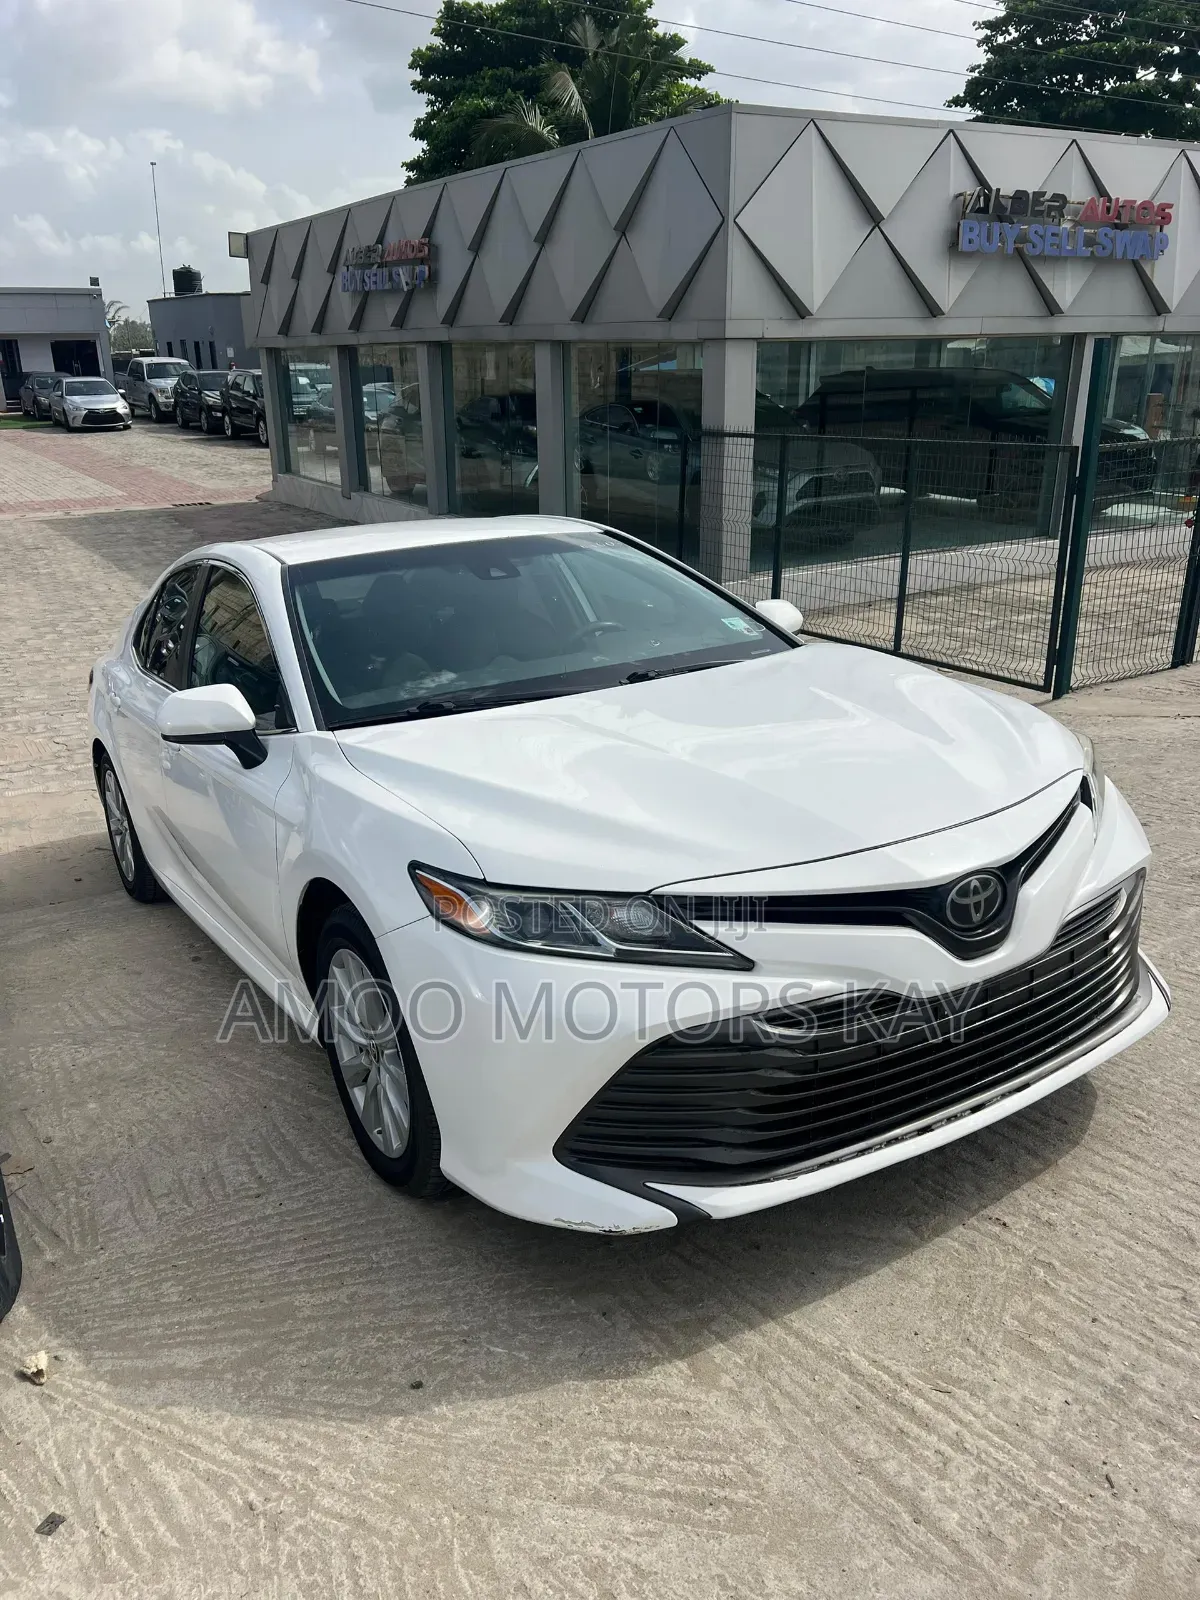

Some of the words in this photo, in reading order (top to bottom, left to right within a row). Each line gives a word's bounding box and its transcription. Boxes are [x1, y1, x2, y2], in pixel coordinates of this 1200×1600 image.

[1078, 197, 1174, 226] AUTOS
[960, 220, 1022, 254] BUY
[1026, 224, 1091, 257] SELL
[1095, 227, 1169, 260] SWAP
